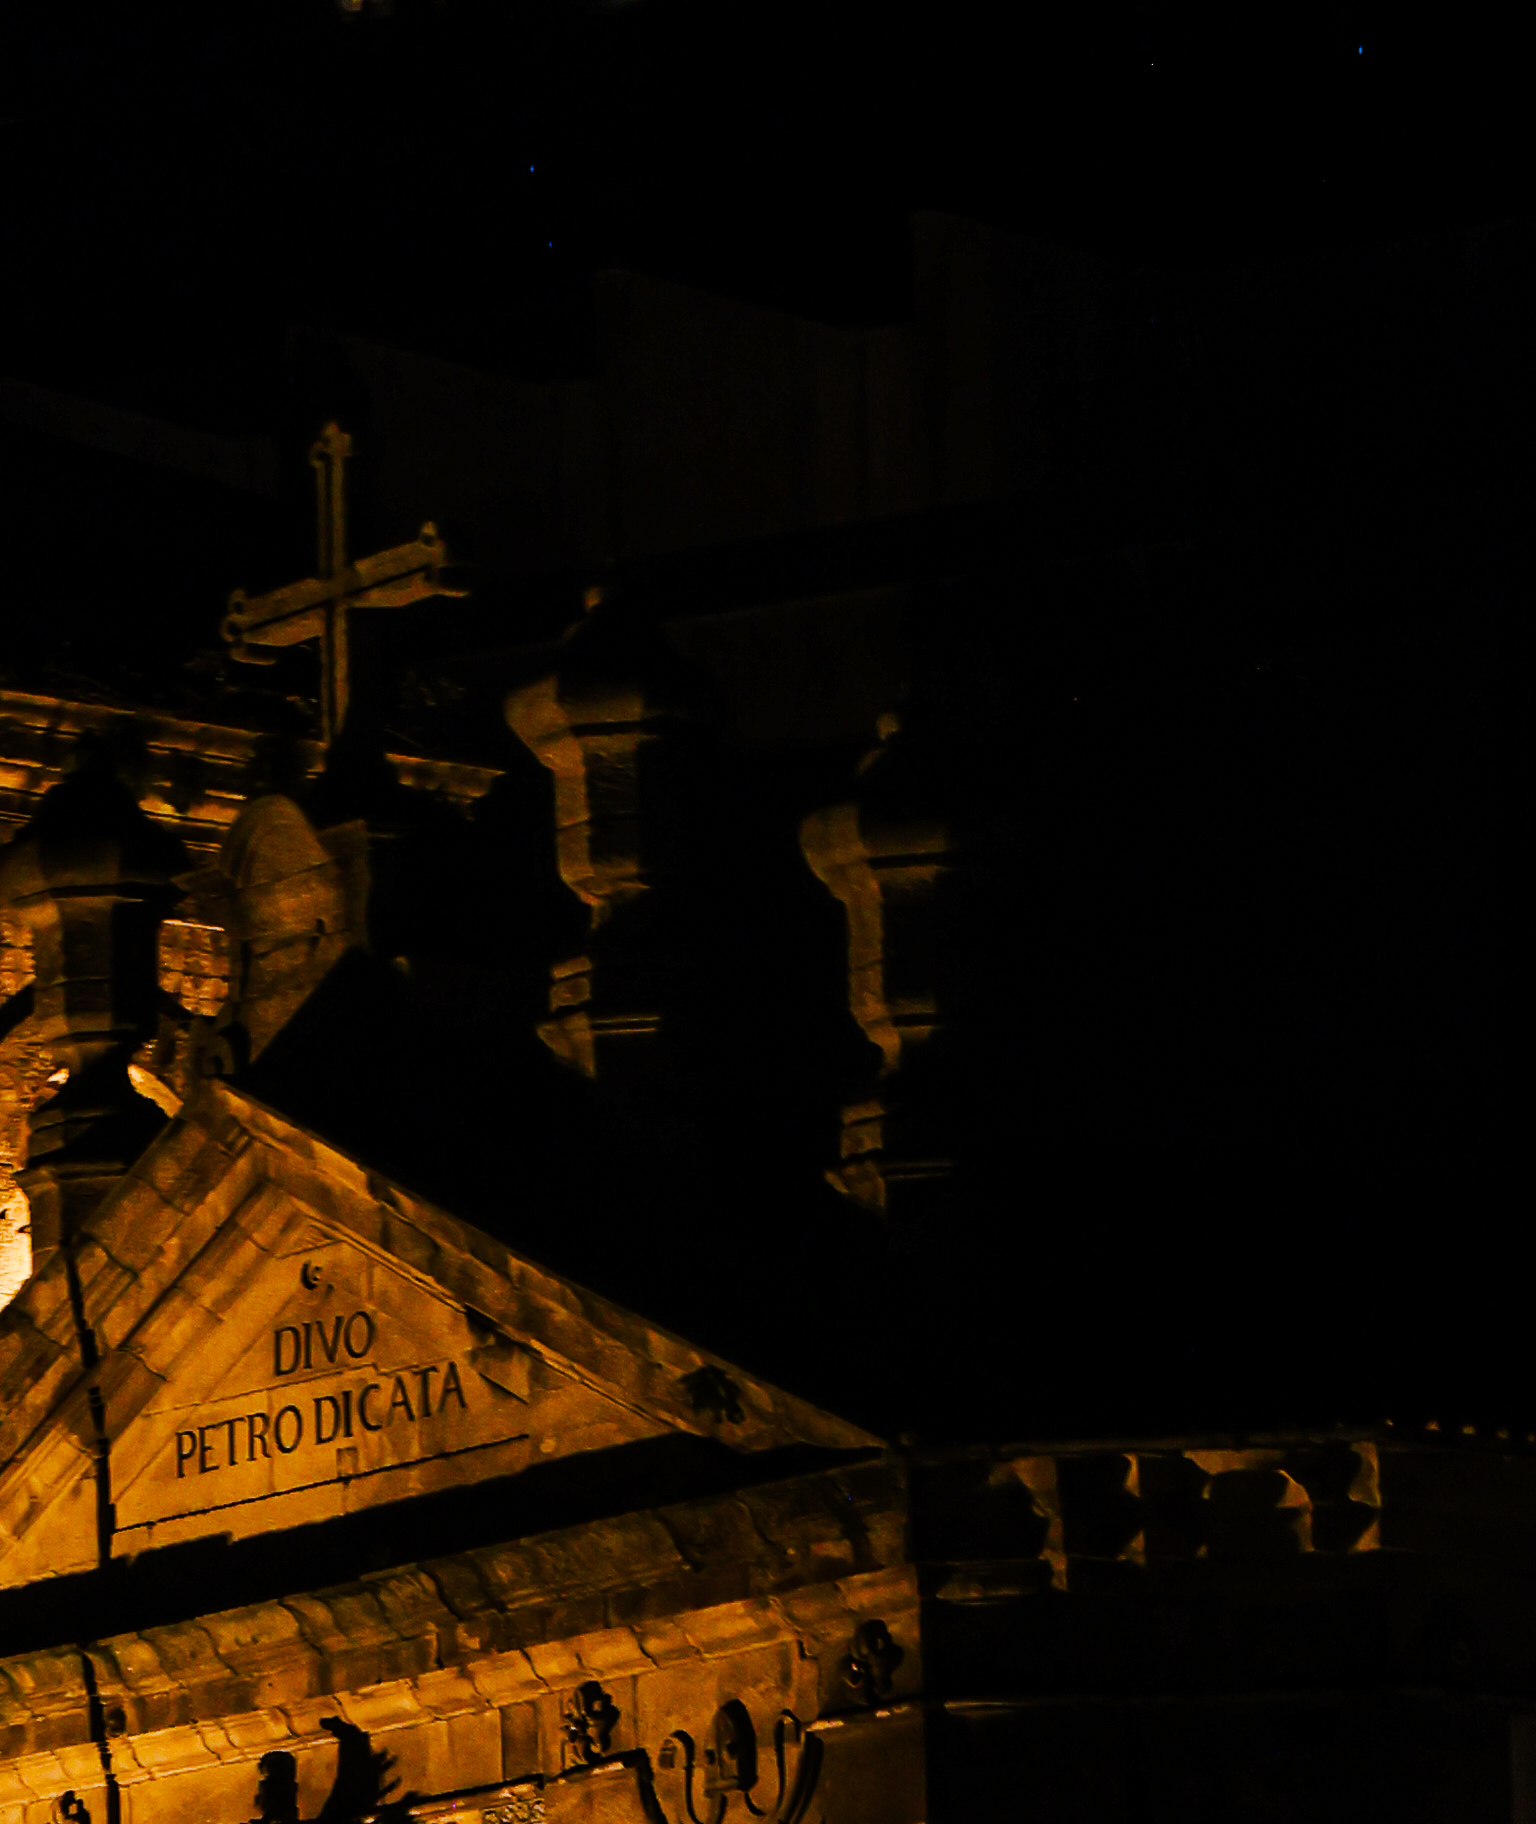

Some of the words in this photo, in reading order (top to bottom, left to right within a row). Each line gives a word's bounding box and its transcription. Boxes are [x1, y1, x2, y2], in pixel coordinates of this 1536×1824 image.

[273, 1311, 375, 1376] DIVO
[175, 1405, 302, 1479] PETRO
[314, 1362, 468, 1445] DICATA
